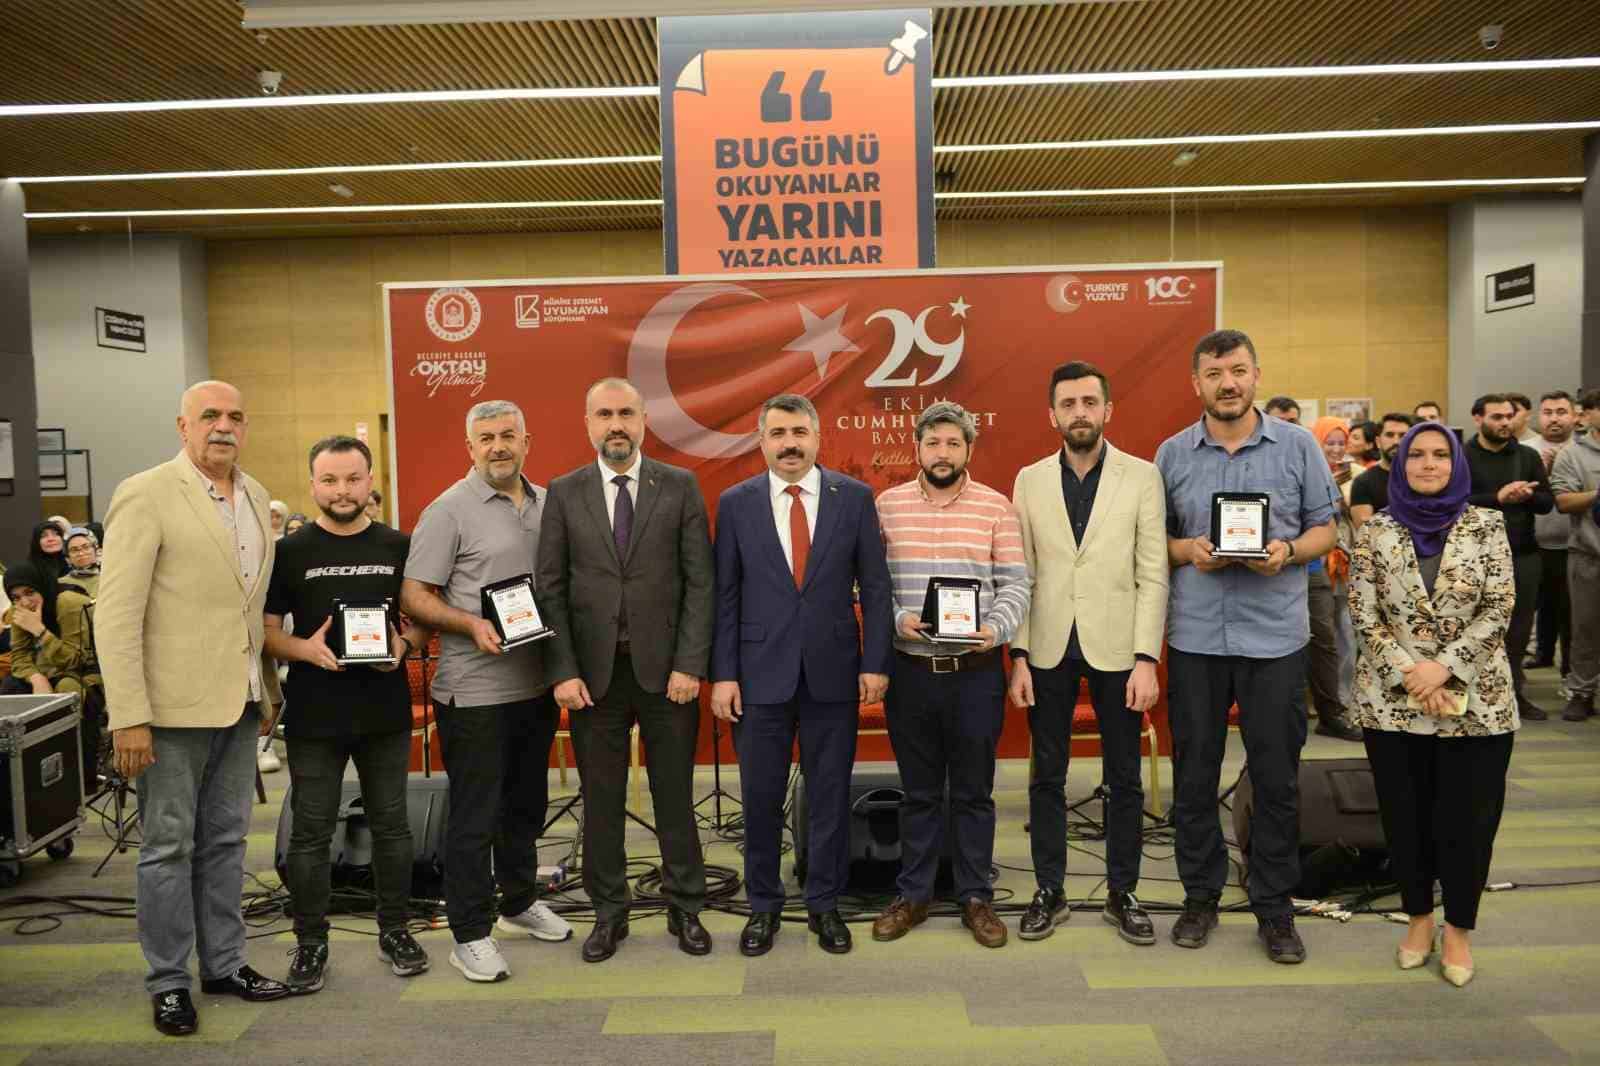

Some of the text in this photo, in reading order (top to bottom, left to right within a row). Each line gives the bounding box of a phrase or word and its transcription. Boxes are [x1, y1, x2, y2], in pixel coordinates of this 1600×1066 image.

[715, 133, 879, 168] BUGÜNÜ
[715, 172, 881, 197] OKUYANLAR
[717, 200, 883, 241] YARINI
[718, 245, 883, 268] YAZACAKLAR
[543, 305, 609, 316] UYUMAYAN
[864, 304, 965, 388] 29
[417, 359, 487, 376] OKTAY
[304, 565, 395, 580] SKECHERS
